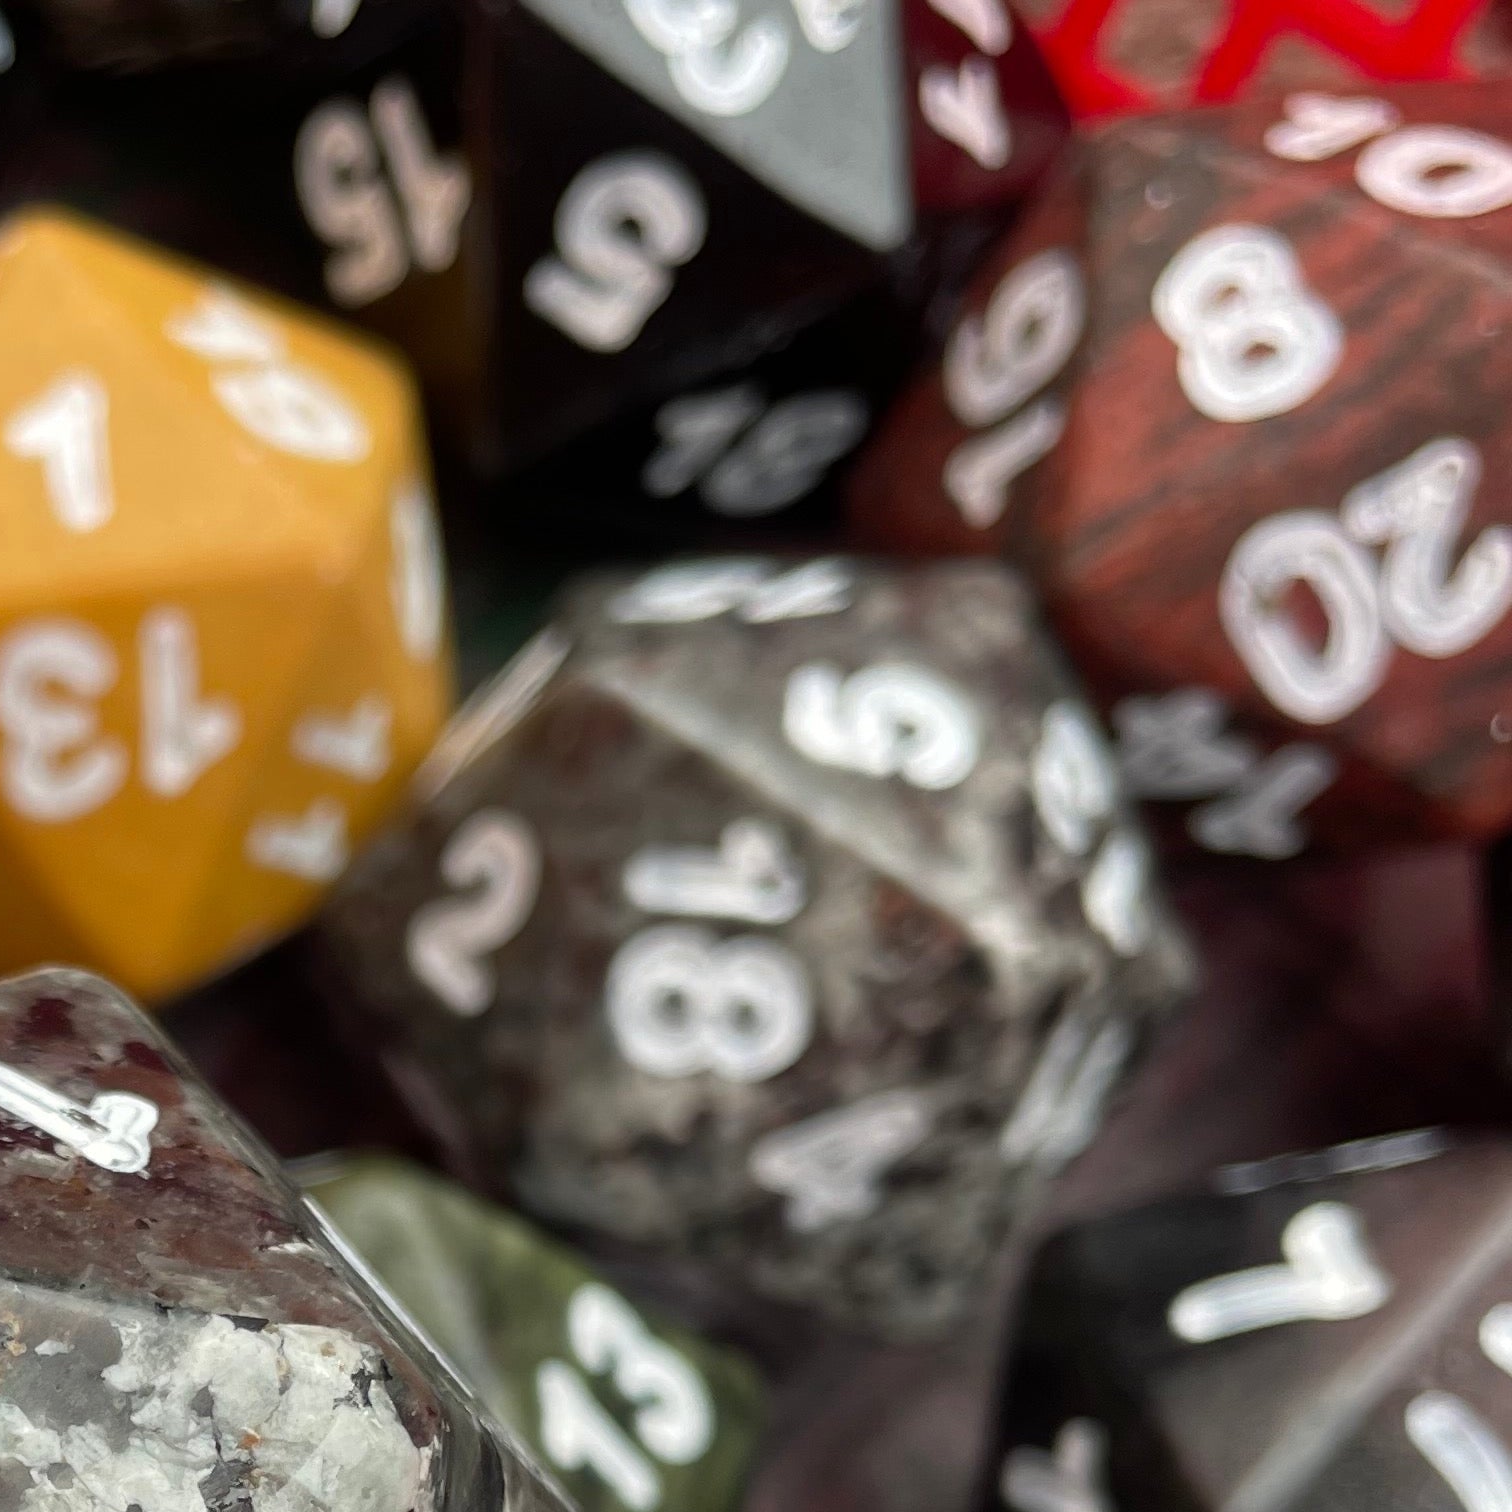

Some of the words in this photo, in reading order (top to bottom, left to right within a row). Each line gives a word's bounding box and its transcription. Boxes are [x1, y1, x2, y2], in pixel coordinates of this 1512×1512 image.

[522, 150, 709, 354] 5
[1263, 94, 1512, 218] 10
[1151, 222, 1345, 423] 8
[1, 367, 115, 532] 1
[1217, 437, 1512, 724] 20
[783, 662, 980, 791] 5
[407, 808, 543, 1016] 2
[605, 816, 814, 1085] 18
